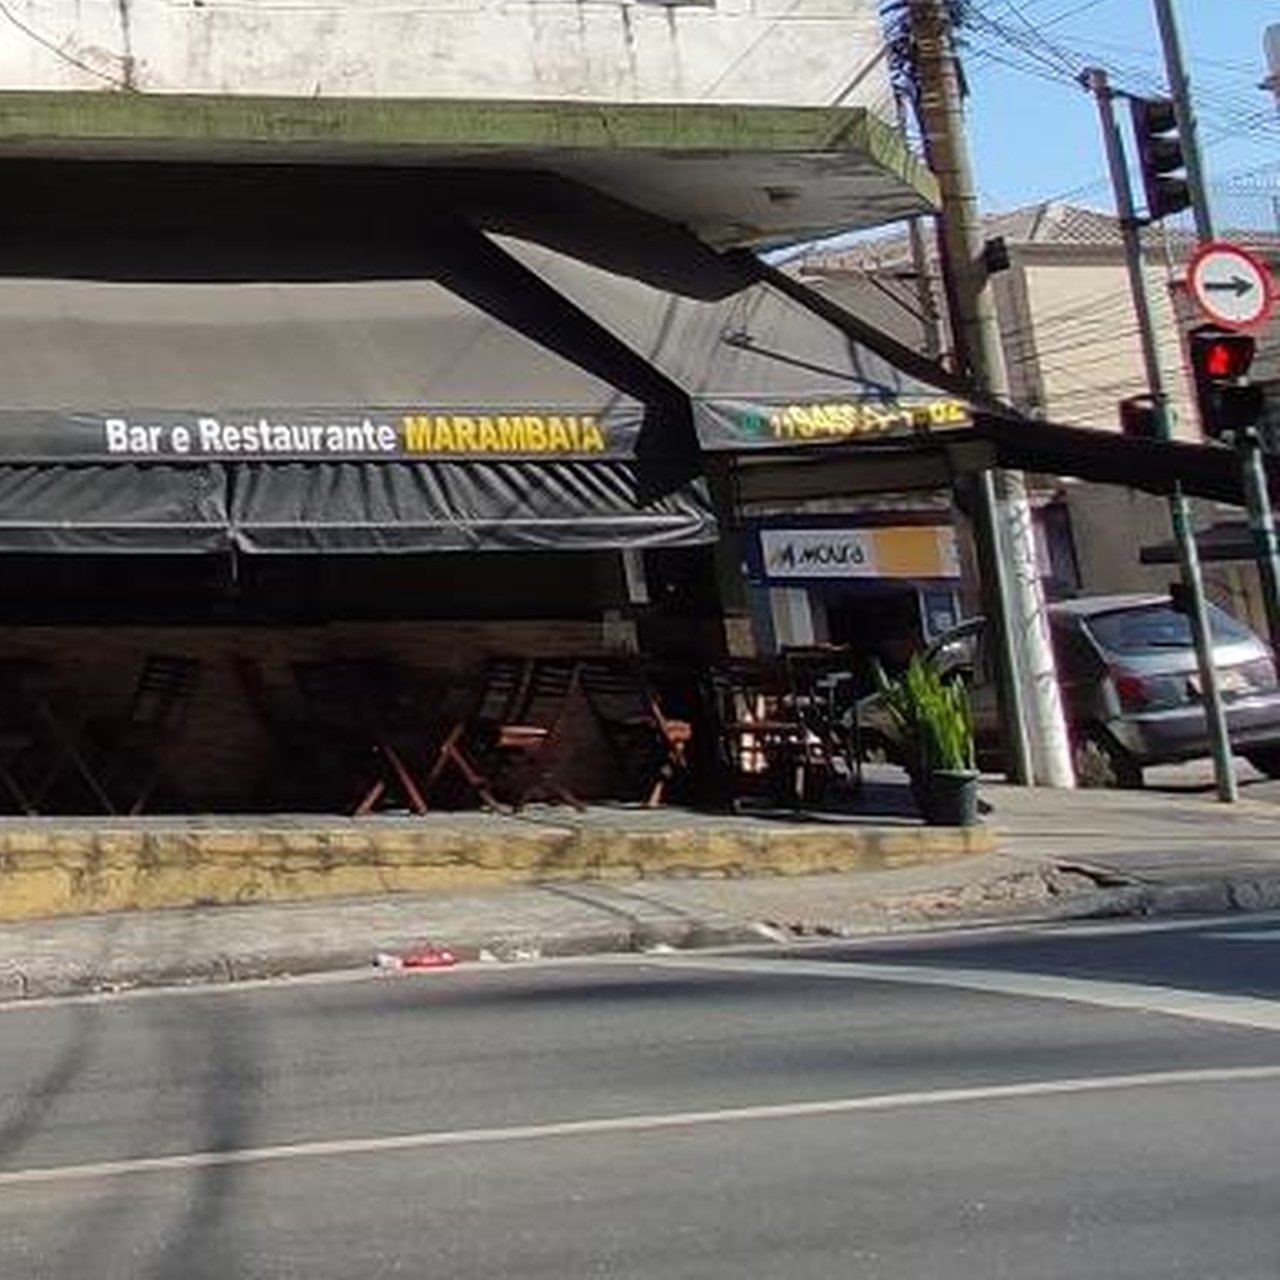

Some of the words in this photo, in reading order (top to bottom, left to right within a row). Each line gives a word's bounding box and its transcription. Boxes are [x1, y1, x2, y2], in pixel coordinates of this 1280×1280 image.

[106, 418, 162, 452] Bar
[171, 423, 190, 452] e
[198, 418, 397, 452] Restaurante
[403, 414, 606, 453] MARAMBAIA
